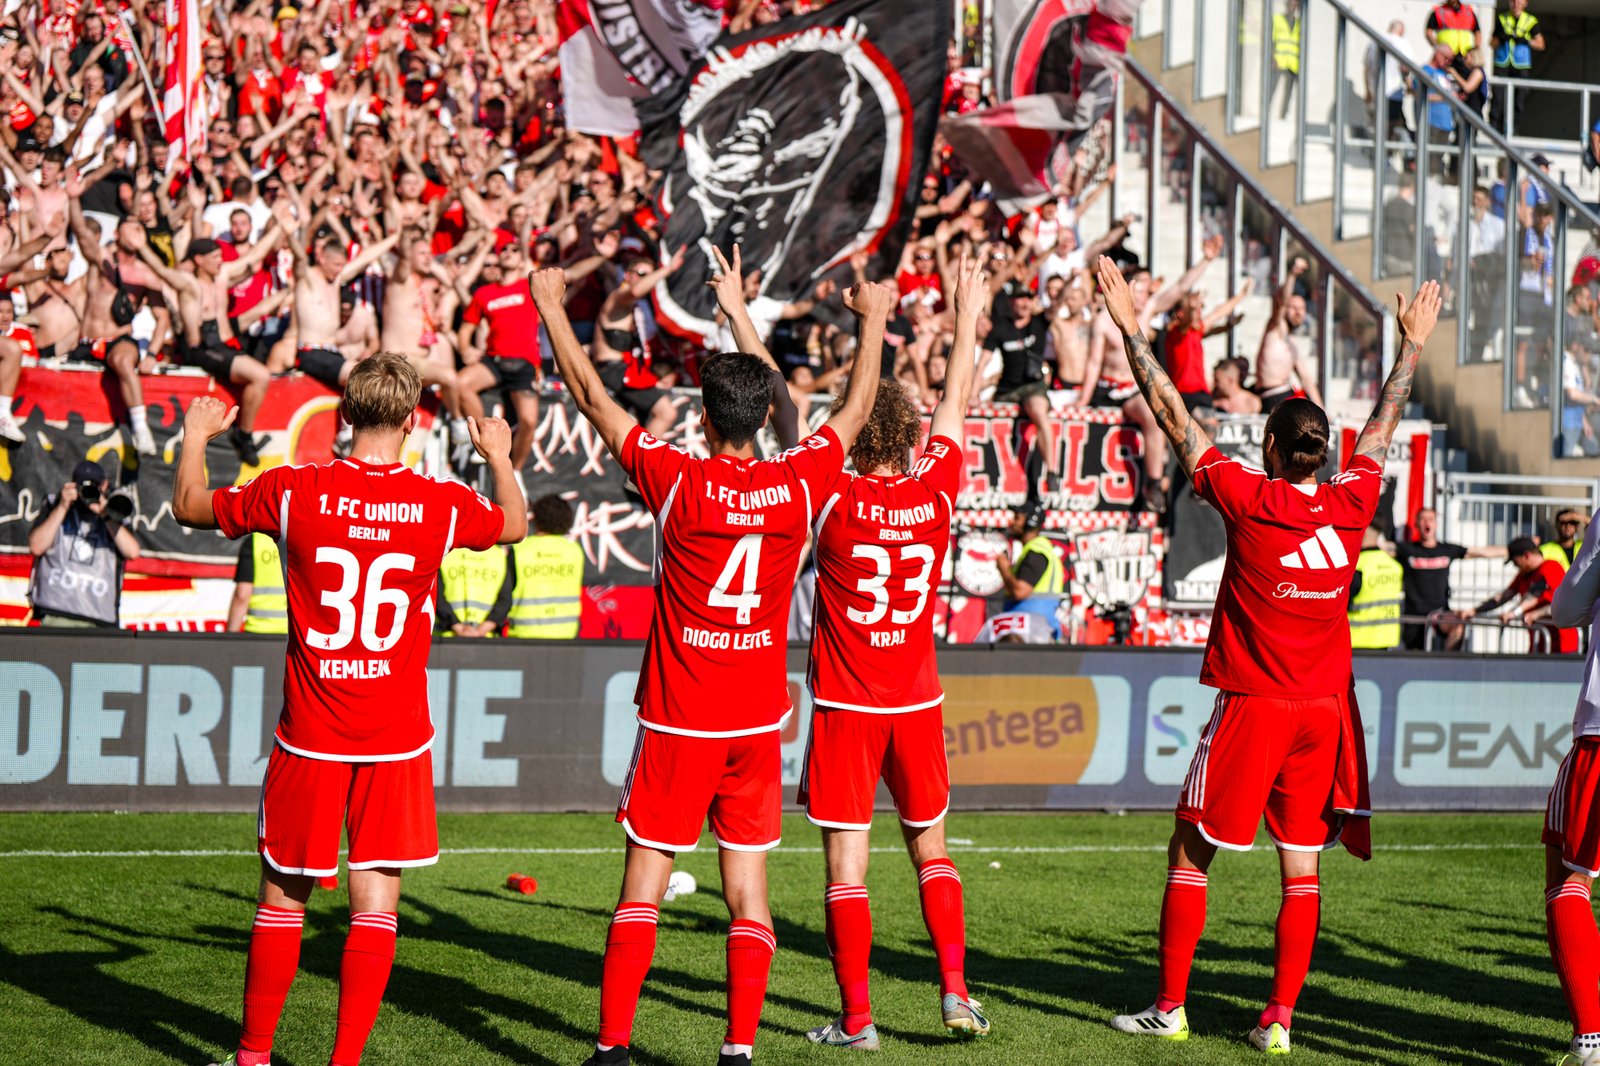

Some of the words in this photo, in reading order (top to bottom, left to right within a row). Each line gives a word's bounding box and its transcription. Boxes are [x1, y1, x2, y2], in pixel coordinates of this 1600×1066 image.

[319, 494, 332, 515] 1.
[336, 496, 361, 518] FC
[364, 502, 424, 523] UNION
[706, 480, 716, 500] 1.
[719, 485, 738, 508] FC
[739, 484, 792, 511] UNION
[726, 512, 765, 526] BERLIN
[857, 501, 867, 520] 1.
[870, 504, 886, 524] FC
[888, 502, 936, 527] UNION
[348, 525, 391, 542] BERLIN
[878, 528, 914, 541] BERLIN
[48, 567, 109, 597] FOTO
[523, 564, 575, 578] ORDNER
[707, 533, 765, 625] 4
[846, 543, 936, 625] 33
[305, 546, 416, 652] 36
[682, 626, 730, 650] DIOGO
[733, 629, 773, 650] LEITE
